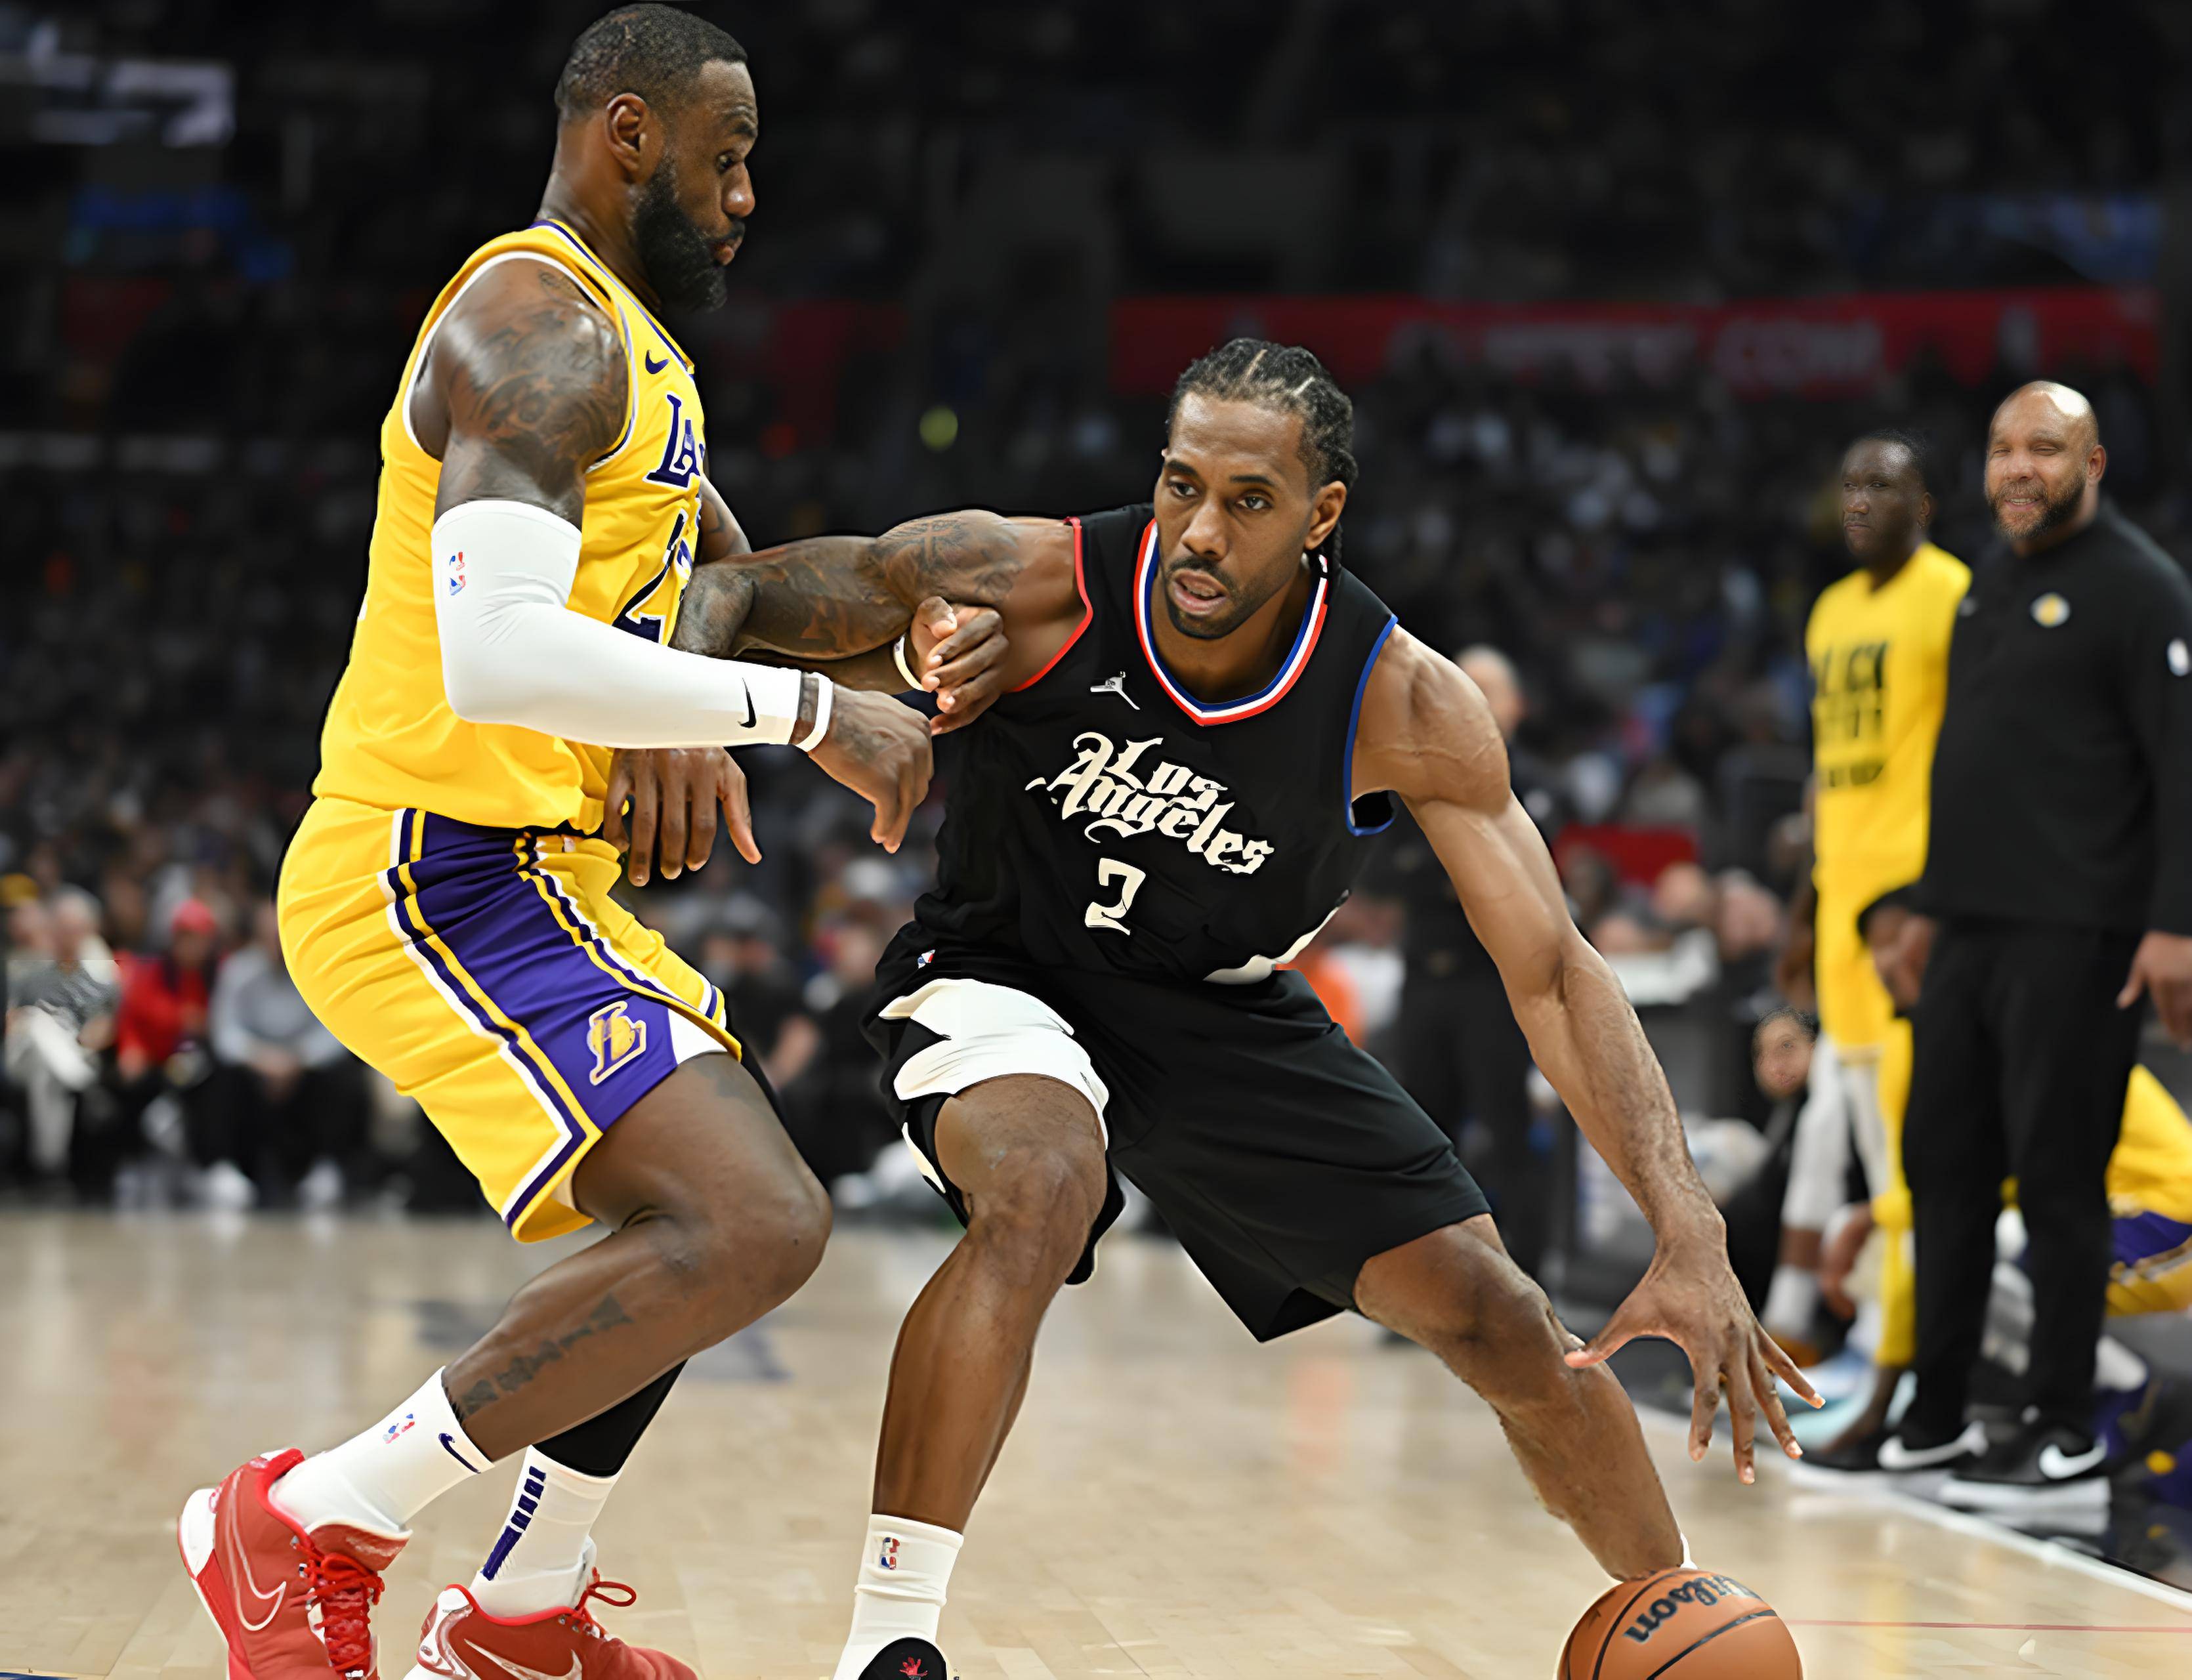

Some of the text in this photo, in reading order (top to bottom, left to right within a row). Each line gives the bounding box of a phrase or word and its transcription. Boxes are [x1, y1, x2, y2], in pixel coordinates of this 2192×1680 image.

[1025, 731, 1275, 875] Angeles
[1103, 736, 1229, 812] Los
[1084, 857, 1147, 936] 2
